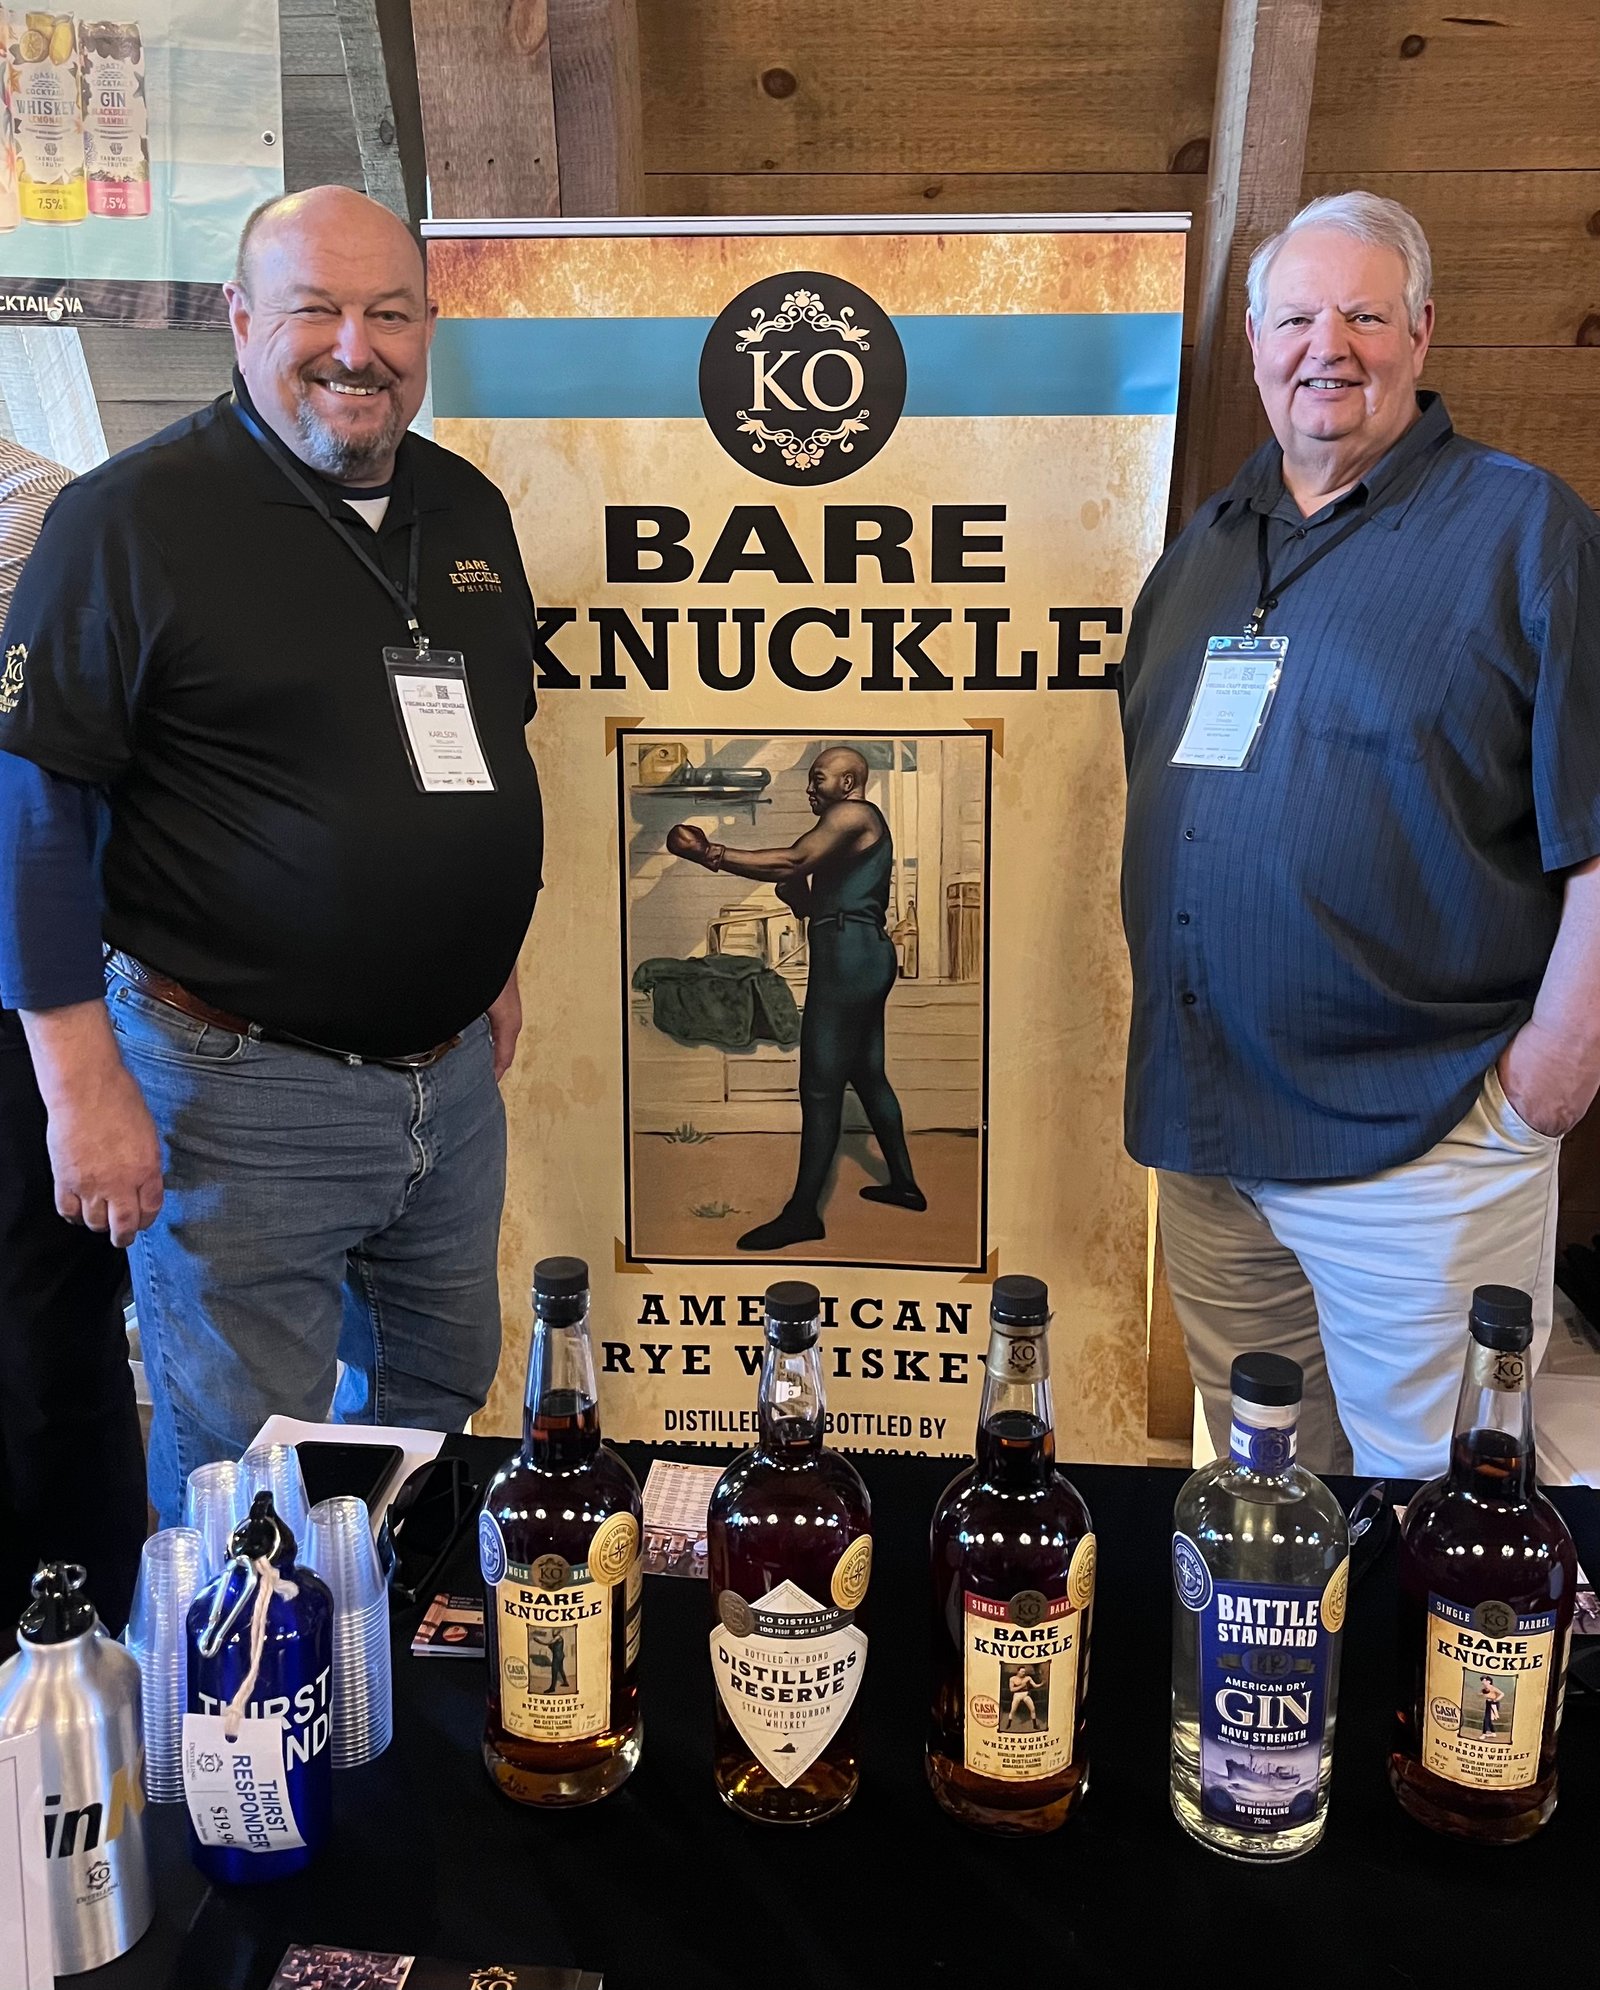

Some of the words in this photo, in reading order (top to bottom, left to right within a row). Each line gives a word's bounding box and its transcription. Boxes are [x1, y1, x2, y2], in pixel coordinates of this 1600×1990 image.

[100, 92, 126, 107] GIN
[16, 100, 75, 116] WHISKEY
[37, 198, 62, 210] 7.5%
[101, 197, 126, 209] 7.5%
[747, 349, 866, 412] KO
[604, 504, 1007, 584] BARE
[455, 560, 490, 571] BARE
[449, 571, 501, 584] KNUCKLE
[533, 607, 1122, 691] KNUCKLE
[5, 657, 24, 682] KO
[637, 1294, 972, 1334] AMEICAN
[1012, 1345, 1036, 1361] KO
[601, 1342, 710, 1375] RYE
[735, 1345, 988, 1384] WISKE
[1498, 1361, 1523, 1377] KO
[665, 1409, 760, 1432] DISTILLED
[824, 1412, 912, 1437] BOTTLED
[919, 1417, 947, 1439] BY
[507, 1566, 529, 1579] NGLE
[573, 1568, 590, 1580] BAR
[540, 1567, 562, 1581] KO
[520, 1590, 584, 1606] BARE
[504, 1600, 602, 1622] KNUCKLE
[972, 1600, 1005, 1616] SINGLE
[1019, 1603, 1040, 1616] KO
[1050, 1600, 1071, 1615] BARR
[1217, 1593, 1320, 1627] BATTLE
[1436, 1601, 1470, 1623] SINGLE
[1485, 1613, 1508, 1626] KO
[1519, 1617, 1550, 1630] BARREL
[759, 1615, 774, 1624] KO
[777, 1611, 839, 1626] DISTILLING
[759, 1626, 774, 1634] 100
[994, 1626, 1058, 1642] BARE
[1217, 1622, 1318, 1648] STANDARD
[974, 1635, 1072, 1659] KNUCKLE
[1458, 1632, 1528, 1655] BARE
[1437, 1638, 1543, 1671] KNUCKLE
[730, 1673, 845, 1703] RESERVE
[1225, 1676, 1283, 1692] AMERICAN
[1286, 1681, 1306, 1692] DRY
[522, 1703, 538, 1711] RYE
[541, 1703, 585, 1713] WHISKEY
[528, 1697, 577, 1705] STRAIGHT
[974, 1703, 996, 1713] CASK
[1215, 1688, 1312, 1729] GIN
[742, 1702, 784, 1719] STRAIGHT
[790, 1705, 831, 1719] BOURBON
[1435, 1704, 1458, 1718] CASK
[766, 1719, 806, 1729] WHISKEY
[998, 1735, 1047, 1744] STRAIGHT
[1221, 1724, 1249, 1741] NAVY
[1252, 1729, 1307, 1743] STRENGTH
[982, 1739, 1016, 1751] WHEAT
[1020, 1738, 1060, 1751] WHISKEY
[1435, 1738, 1484, 1759] BOURBON
[1487, 1752, 1531, 1761] WHISKEY
[1457, 1740, 1511, 1754] STRAIGHT
[202, 1754, 216, 1773] KO
[1471, 1765, 1503, 1773] DISTILLING
[232, 1755, 272, 1849] RESPONDER
[258, 1780, 288, 1832] THIRST
[1235, 1804, 1246, 1813] KO
[1247, 1806, 1290, 1816] DISTILLING
[89, 1867, 110, 1884] KO
